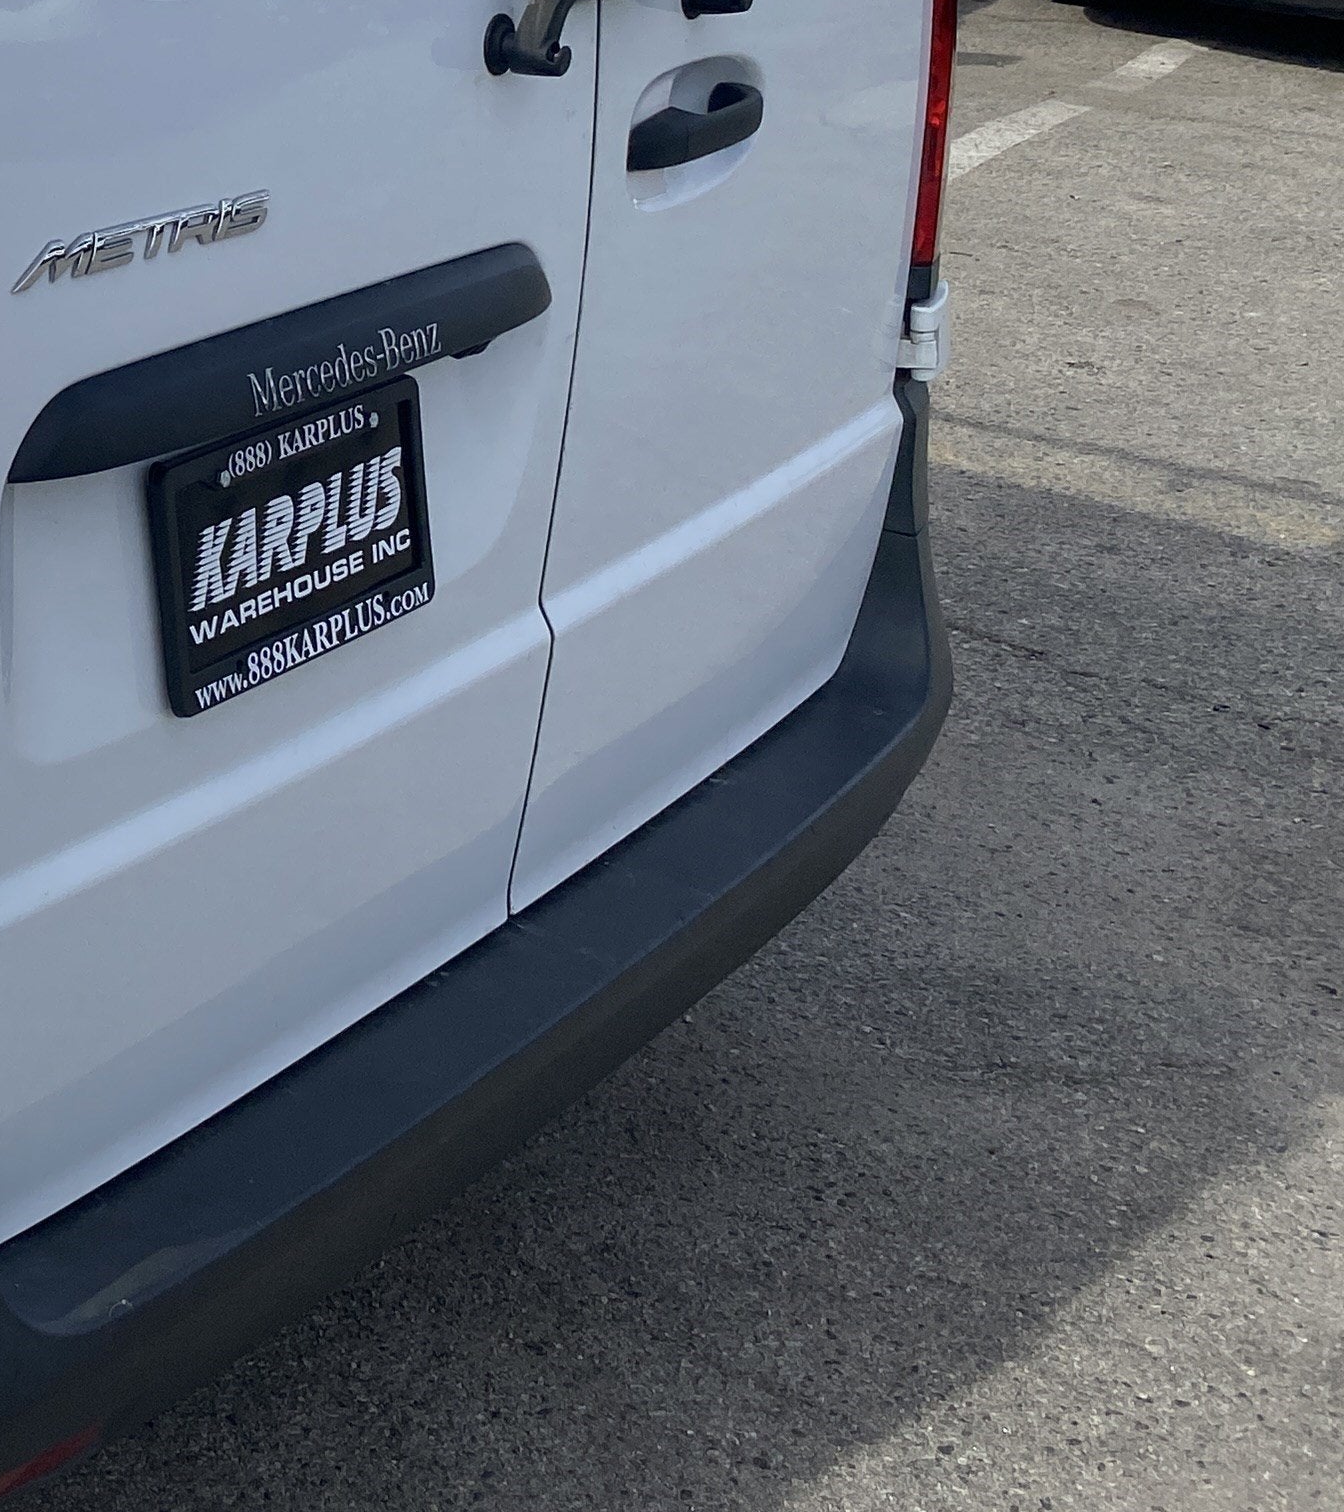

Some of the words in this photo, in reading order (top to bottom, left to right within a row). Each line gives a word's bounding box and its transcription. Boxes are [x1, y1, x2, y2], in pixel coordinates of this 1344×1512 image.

[12, 189, 270, 294] METRIS
[247, 321, 442, 417] Mercedes-Benz
[228, 439, 272, 478] (888)
[278, 404, 365, 461] KARPLUS
[189, 447, 403, 613] KARPLUS
[189, 561, 365, 645] WAREHOUSE
[372, 528, 412, 566] INC
